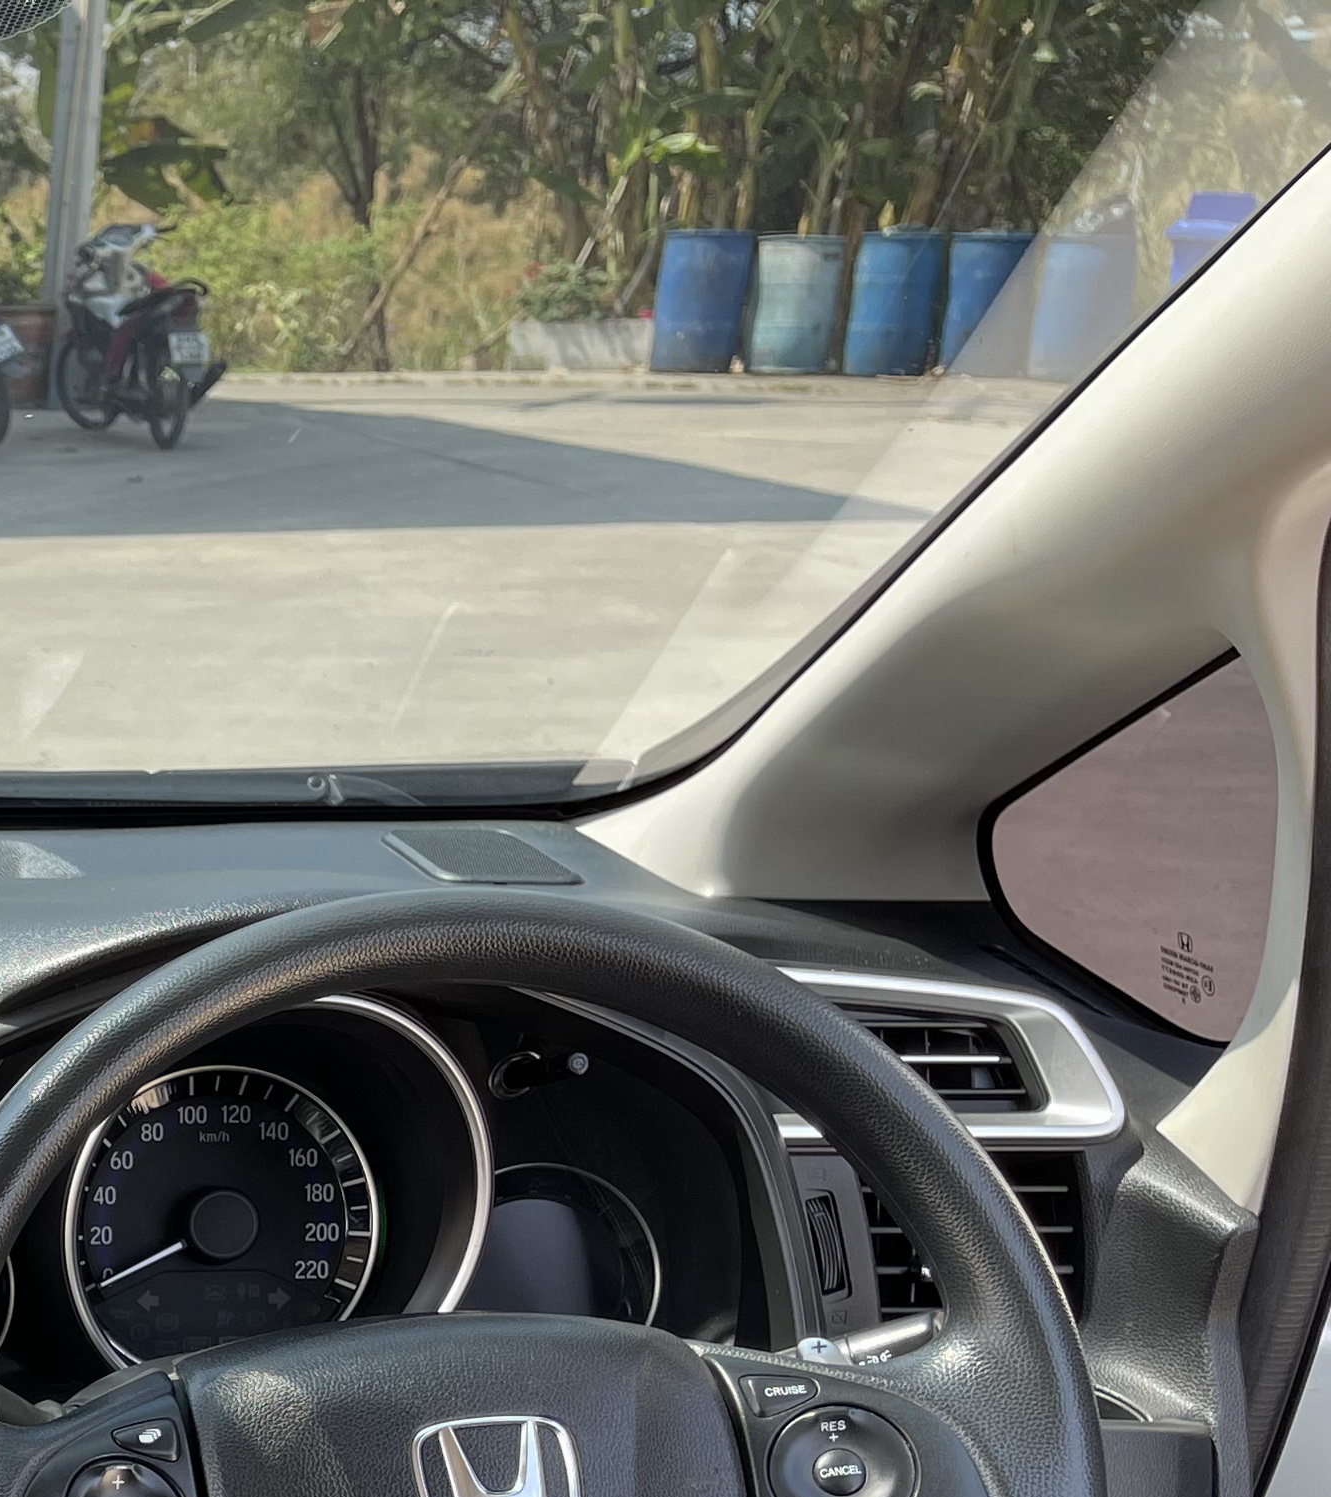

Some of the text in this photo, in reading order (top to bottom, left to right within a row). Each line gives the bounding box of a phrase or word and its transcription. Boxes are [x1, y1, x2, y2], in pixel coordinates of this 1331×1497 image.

[177, 1105, 208, 1125] 100
[221, 1104, 252, 1124] 120
[140, 1122, 164, 1143] 80
[198, 1130, 230, 1143] km/h
[258, 1121, 289, 1142] 140
[109, 1150, 134, 1170] 60
[289, 1148, 318, 1168] 160
[93, 1185, 117, 1205] 40
[304, 1183, 335, 1203] 180
[90, 1226, 113, 1246] 20
[304, 1222, 340, 1243] 200
[294, 1260, 330, 1280] 220
[764, 1384, 808, 1398] CRUISE
[820, 1419, 847, 1433] RES
[819, 1464, 863, 1479] CANCEL
